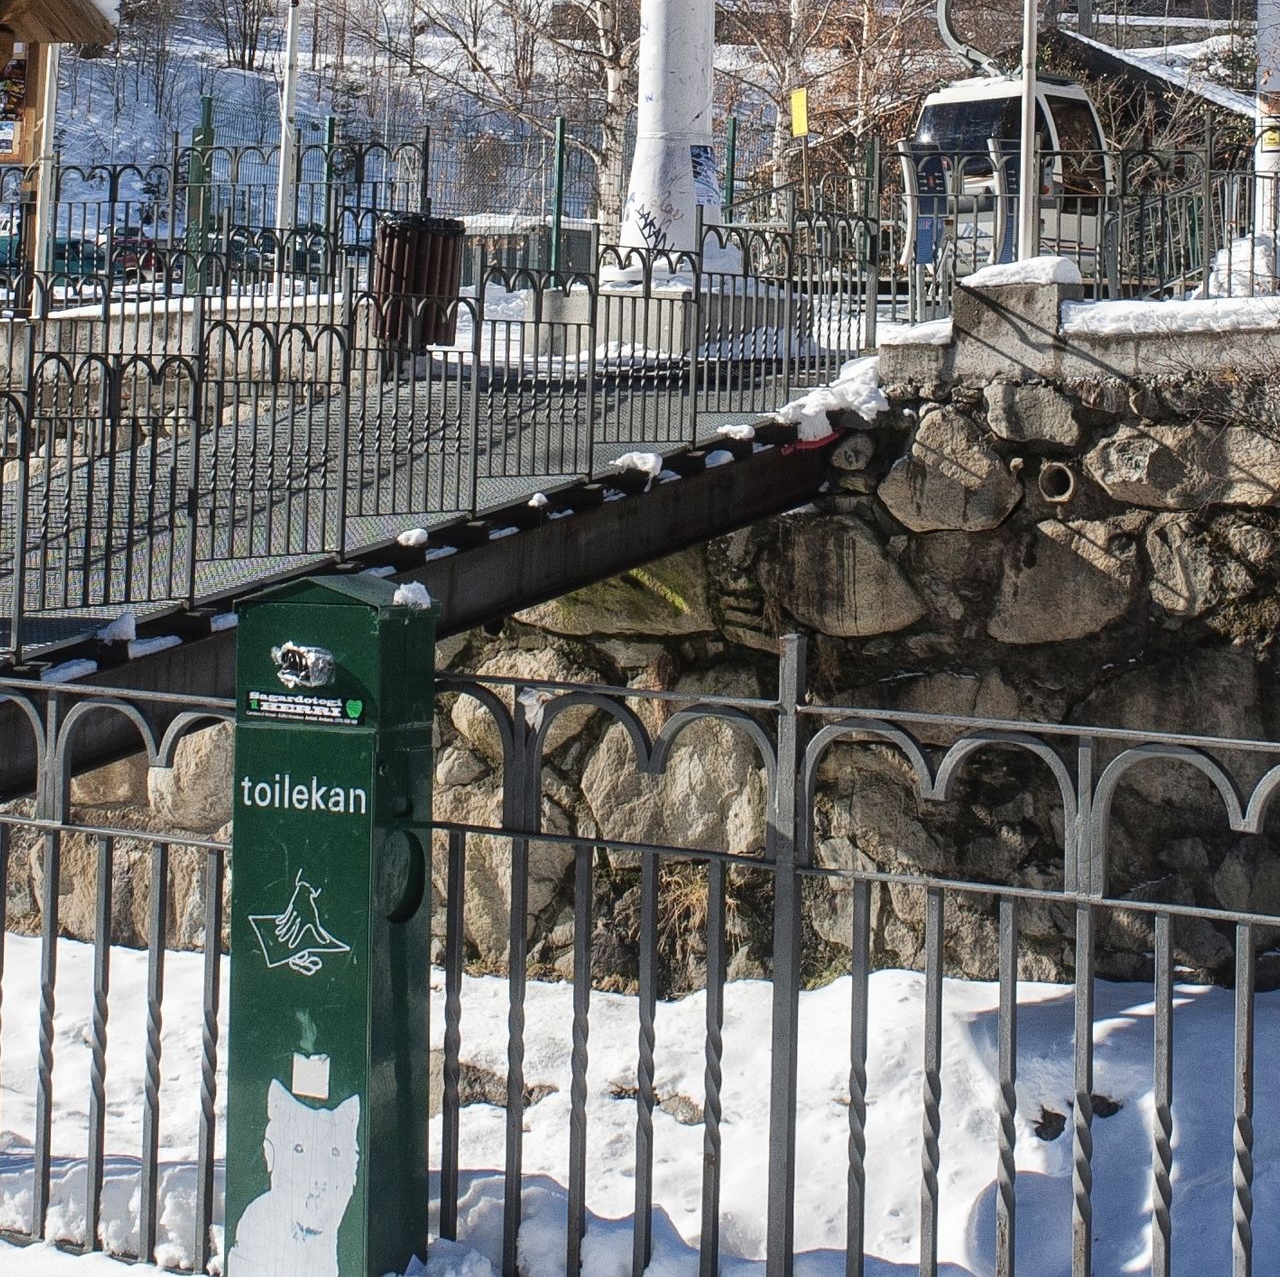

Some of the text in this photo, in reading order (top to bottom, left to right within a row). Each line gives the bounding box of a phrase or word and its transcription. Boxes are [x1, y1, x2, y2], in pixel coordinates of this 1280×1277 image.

[249, 691, 342, 706] Sagardotegi
[261, 701, 341, 717] HERRI
[241, 774, 366, 814] toilekan
